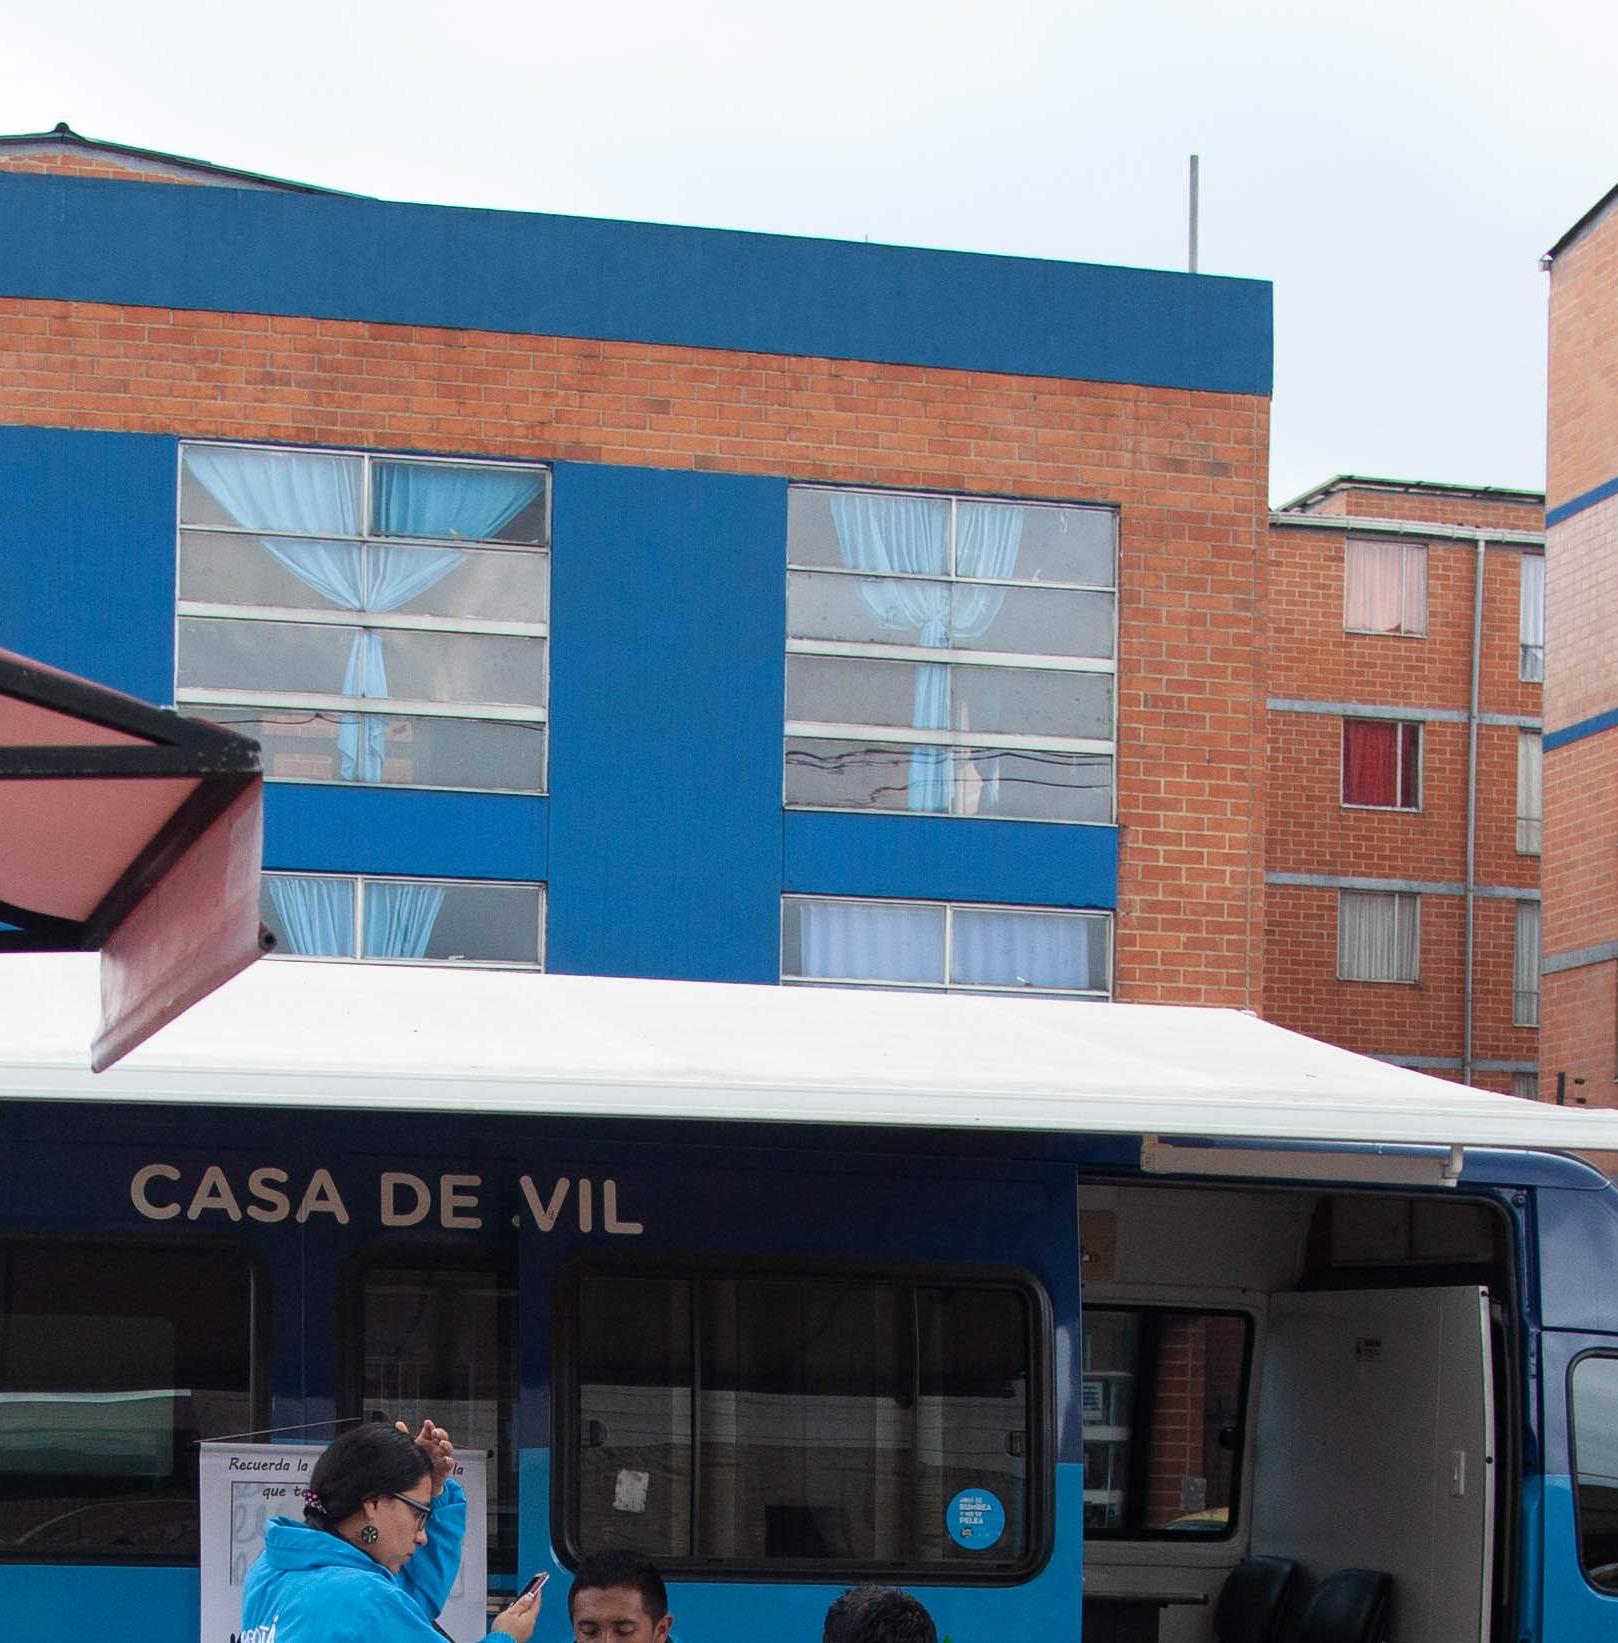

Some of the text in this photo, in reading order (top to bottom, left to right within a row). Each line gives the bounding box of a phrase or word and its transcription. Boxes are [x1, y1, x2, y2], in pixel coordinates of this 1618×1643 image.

[131, 1163, 644, 1235] CASA DE VIL
[228, 1457, 309, 1472] Recuerda la
[262, 1487, 287, 1500] que
